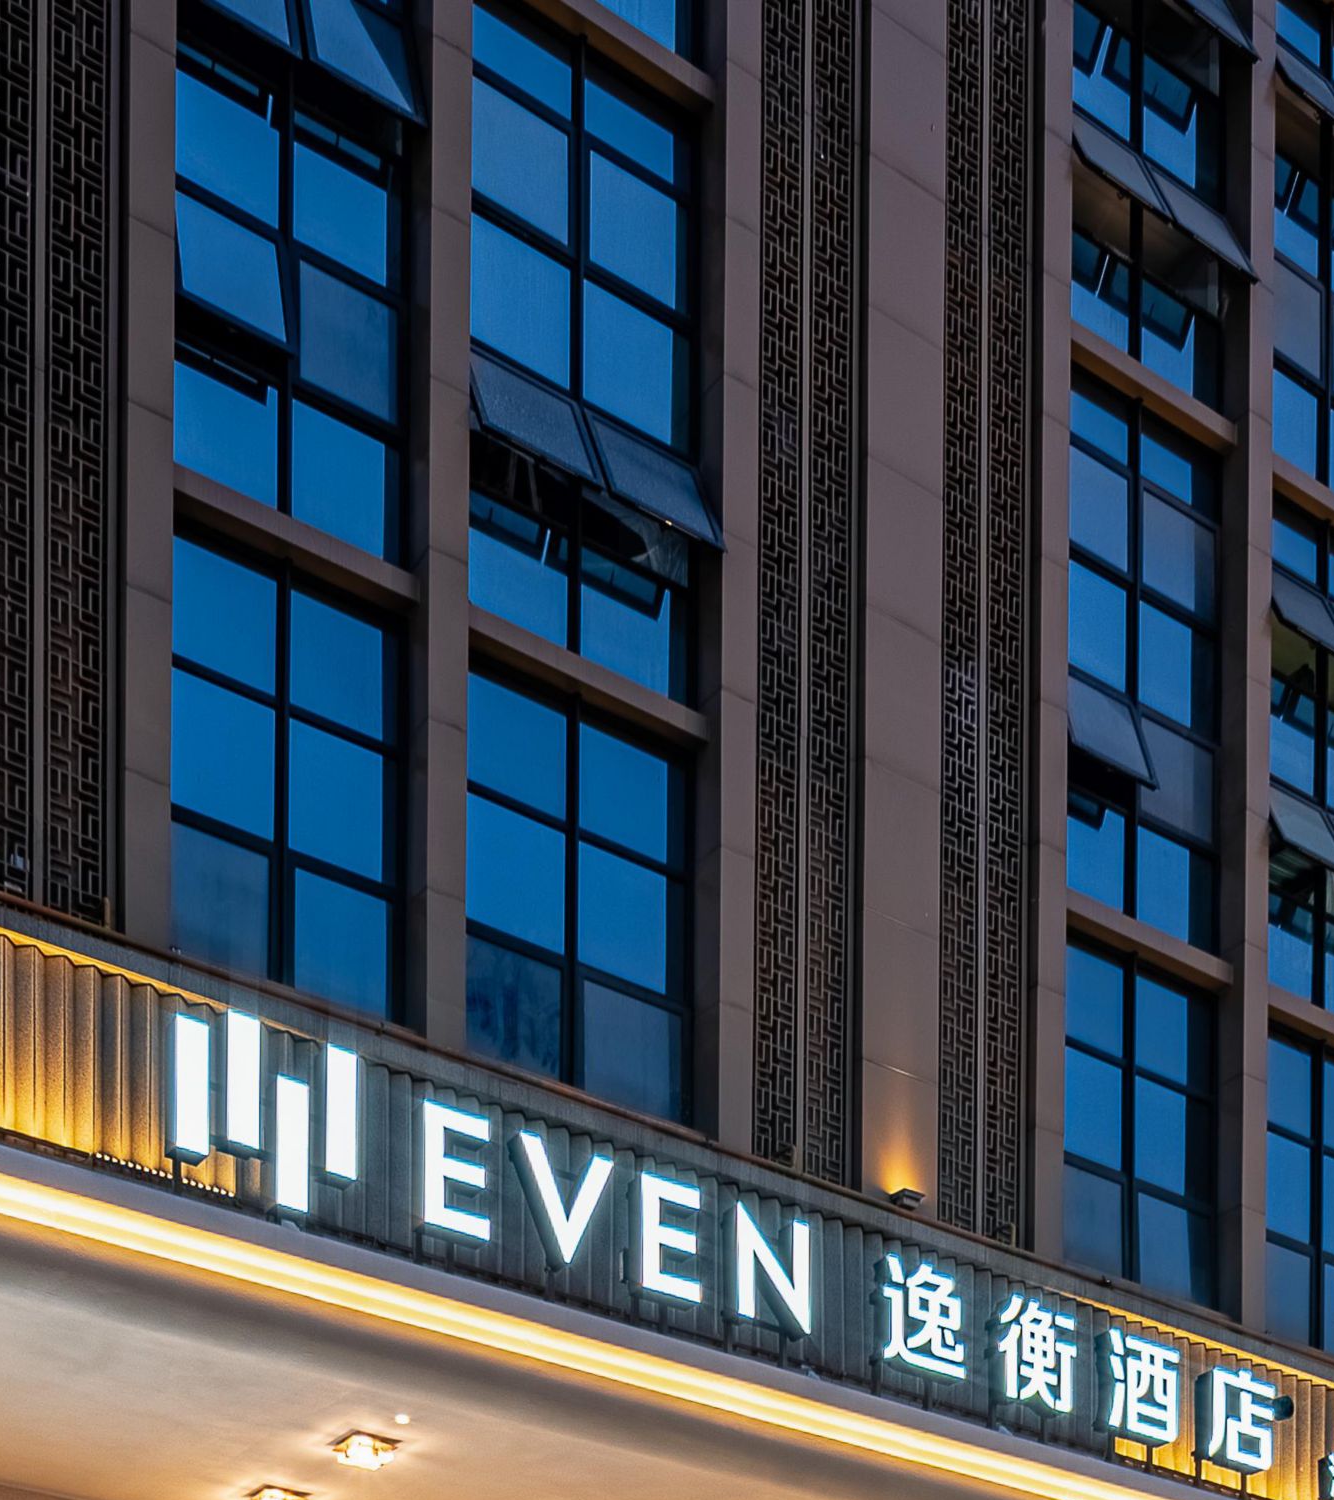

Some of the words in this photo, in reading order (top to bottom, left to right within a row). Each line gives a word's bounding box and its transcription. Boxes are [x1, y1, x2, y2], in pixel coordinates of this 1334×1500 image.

[423, 1098, 812, 1335] EVEN
[882, 1252, 1277, 1471] 逸衡酒店
